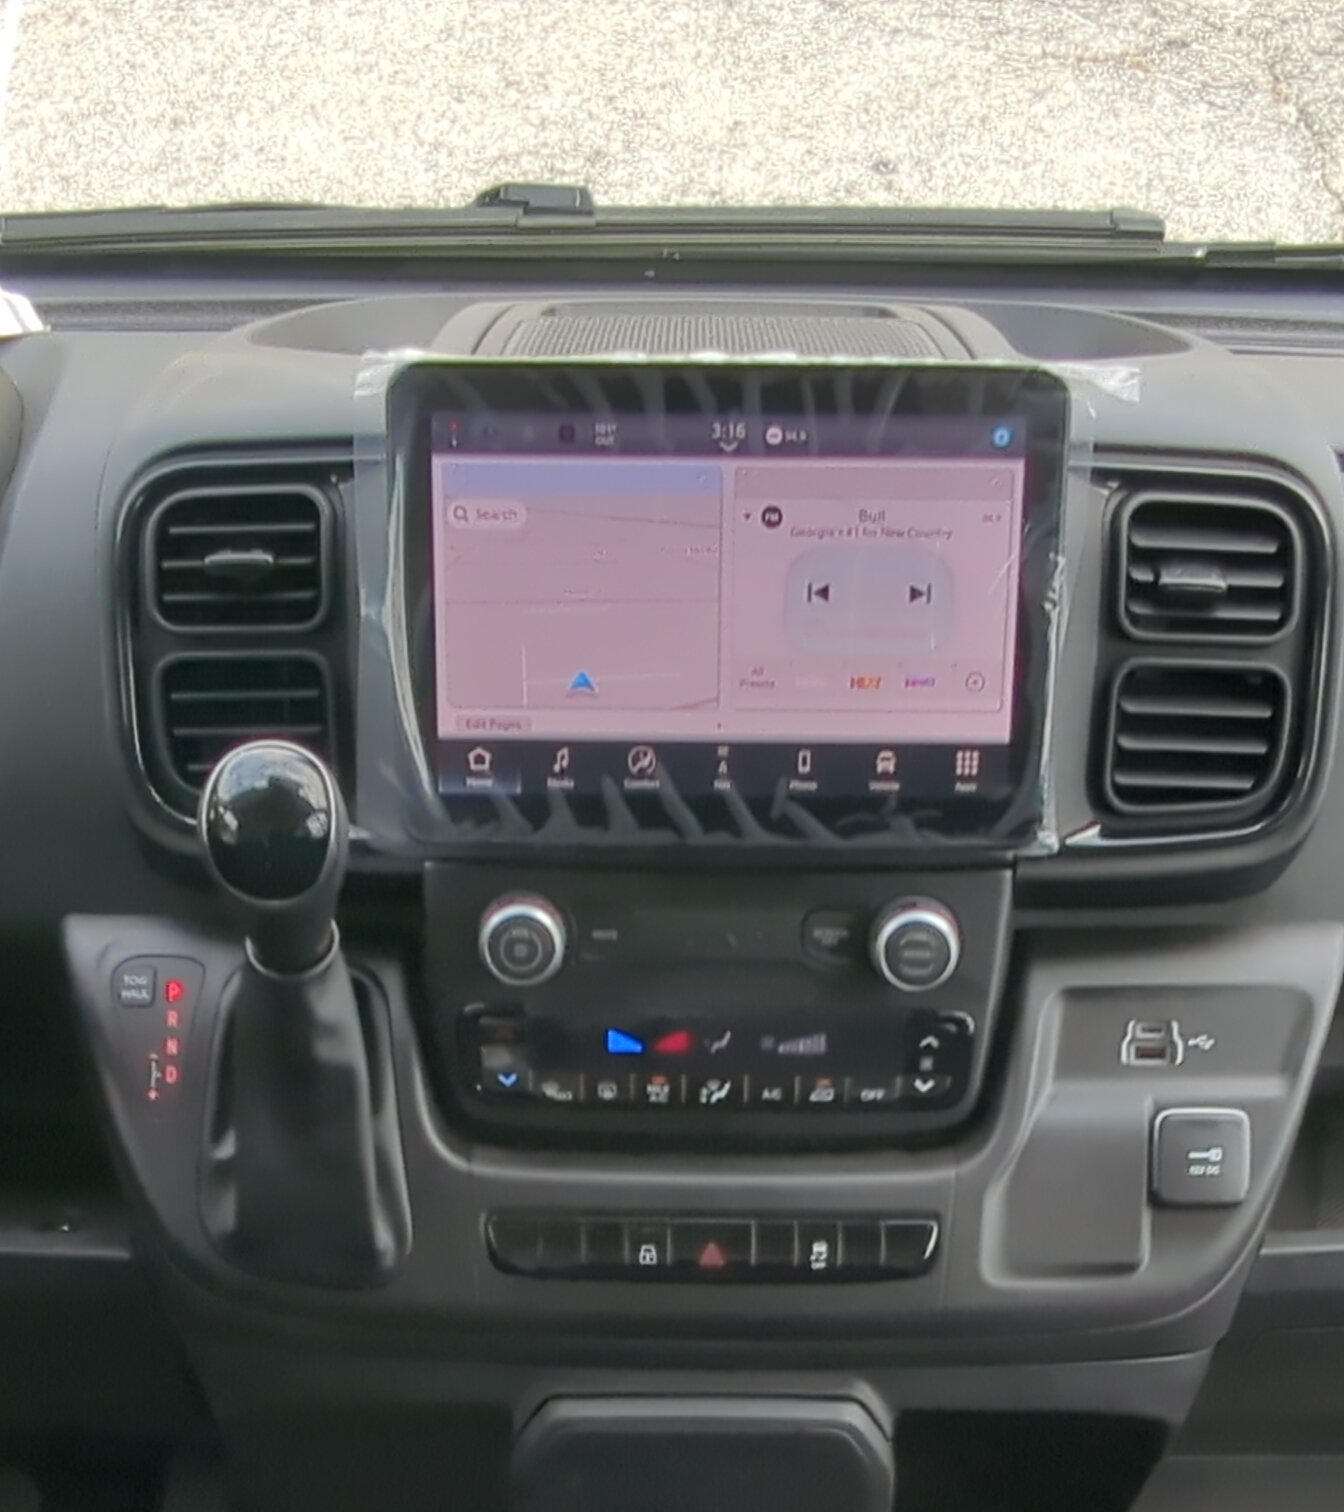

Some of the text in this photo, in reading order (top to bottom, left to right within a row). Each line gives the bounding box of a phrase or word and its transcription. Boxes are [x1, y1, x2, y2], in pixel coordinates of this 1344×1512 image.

[712, 422, 746, 439] 3:16
[476, 508, 518, 521] Search
[858, 508, 886, 523] Bull
[465, 719, 487, 730] Edit
[166, 978, 184, 1003] P
[167, 1009, 179, 1028] R
[166, 1038, 179, 1056] N
[164, 1064, 178, 1084] D
[860, 1087, 887, 1102] OFF
